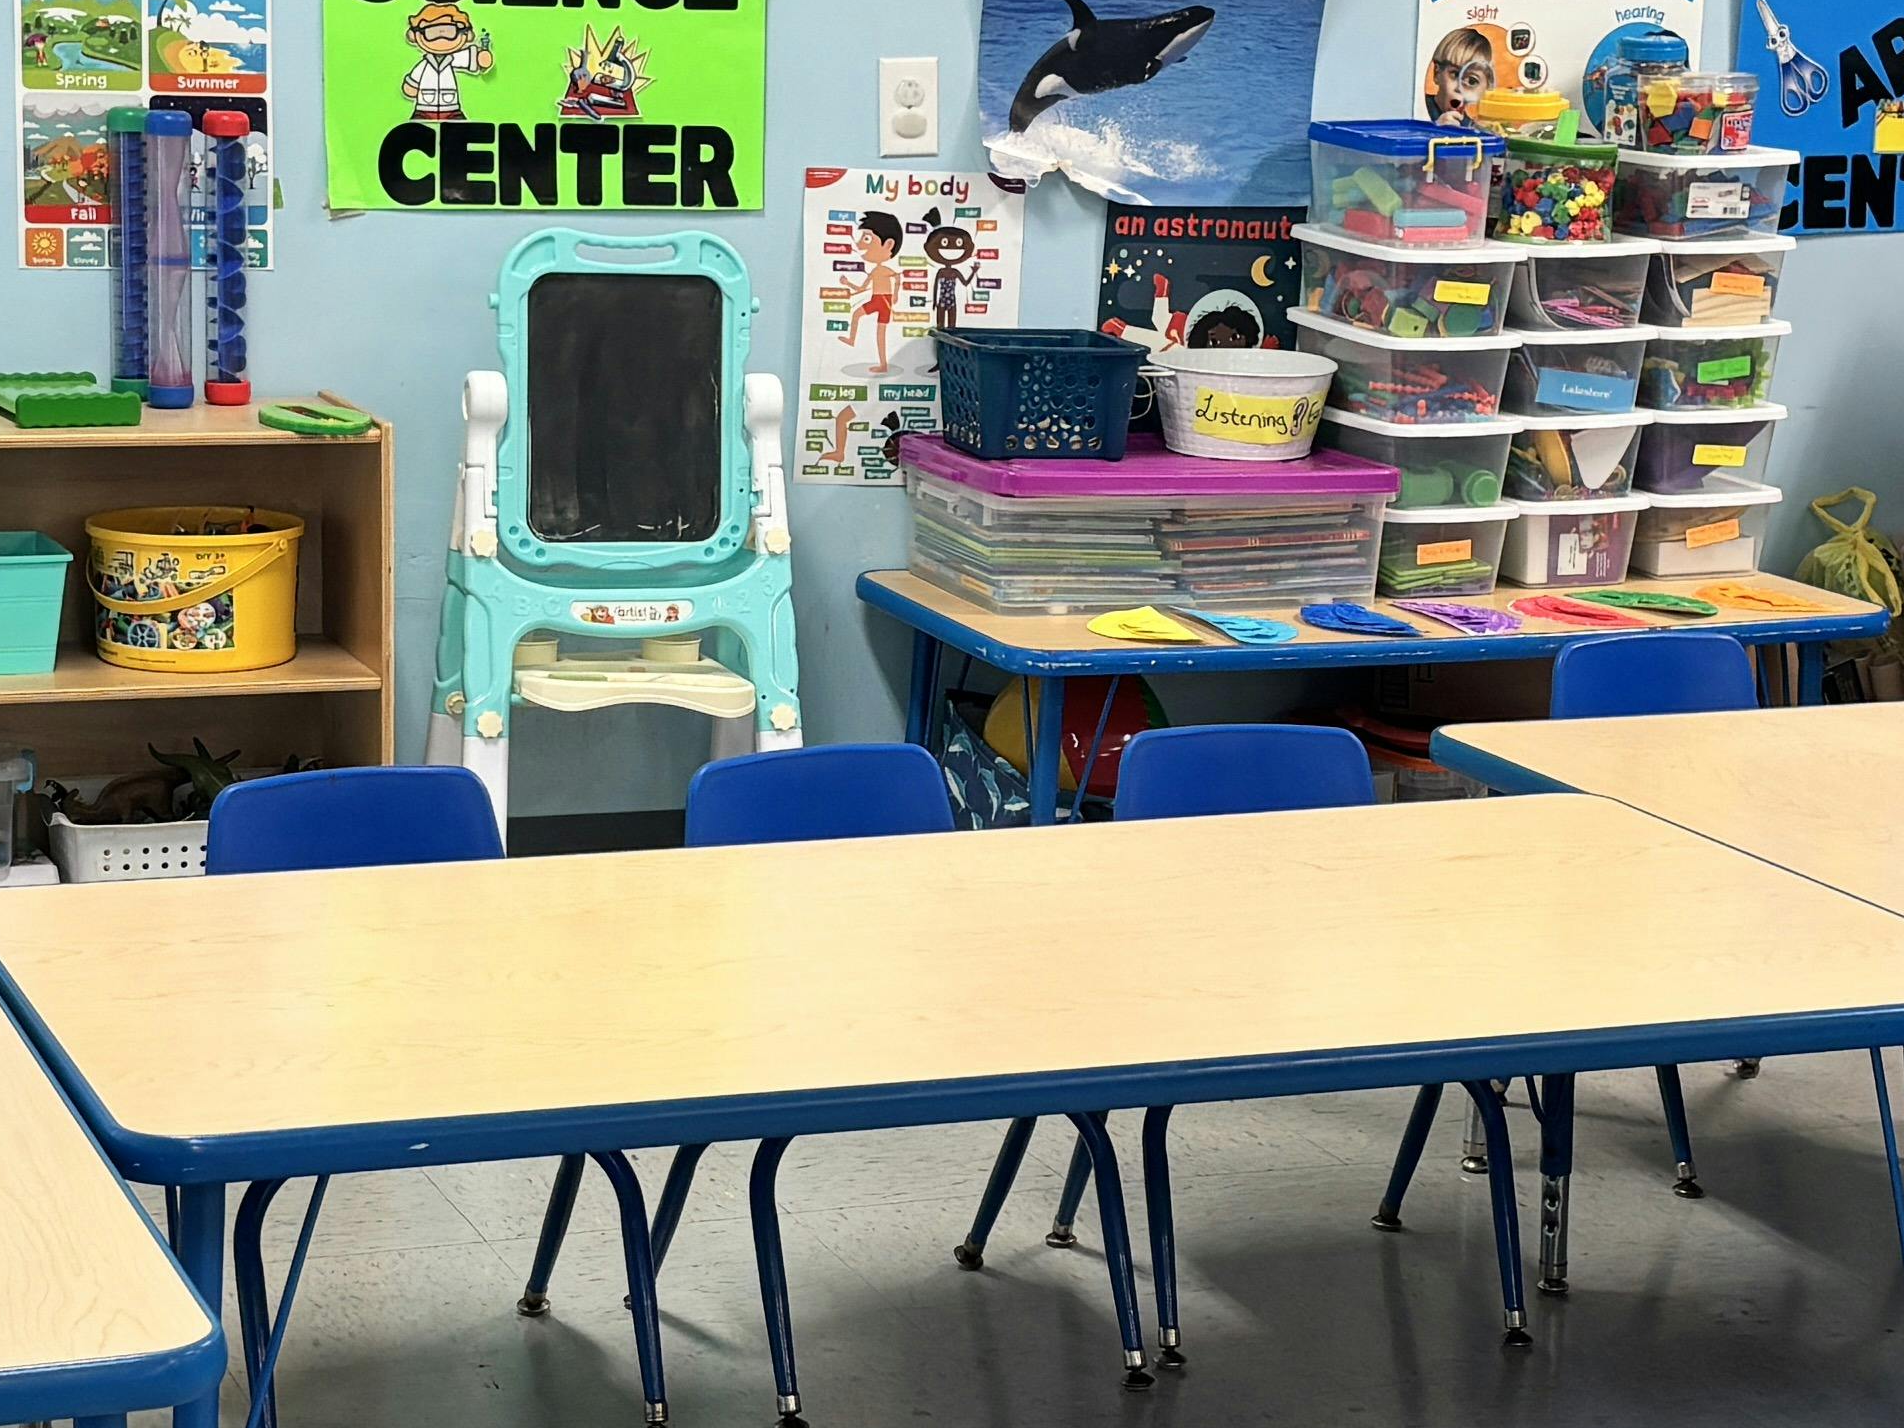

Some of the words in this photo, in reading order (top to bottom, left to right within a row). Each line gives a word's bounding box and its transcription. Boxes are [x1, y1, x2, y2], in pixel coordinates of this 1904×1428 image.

[1467, 5, 1499, 21] sight
[1615, 6, 1665, 24] hearing
[54, 72, 108, 91] Spring
[176, 75, 240, 92] Summer
[378, 121, 738, 207] CENTER
[866, 173, 899, 202] My
[908, 174, 969, 204] body
[71, 209, 97, 221] Fall
[1114, 215, 1146, 238] an
[1154, 213, 1293, 242] astronaut
[1196, 394, 1288, 435] Listening
